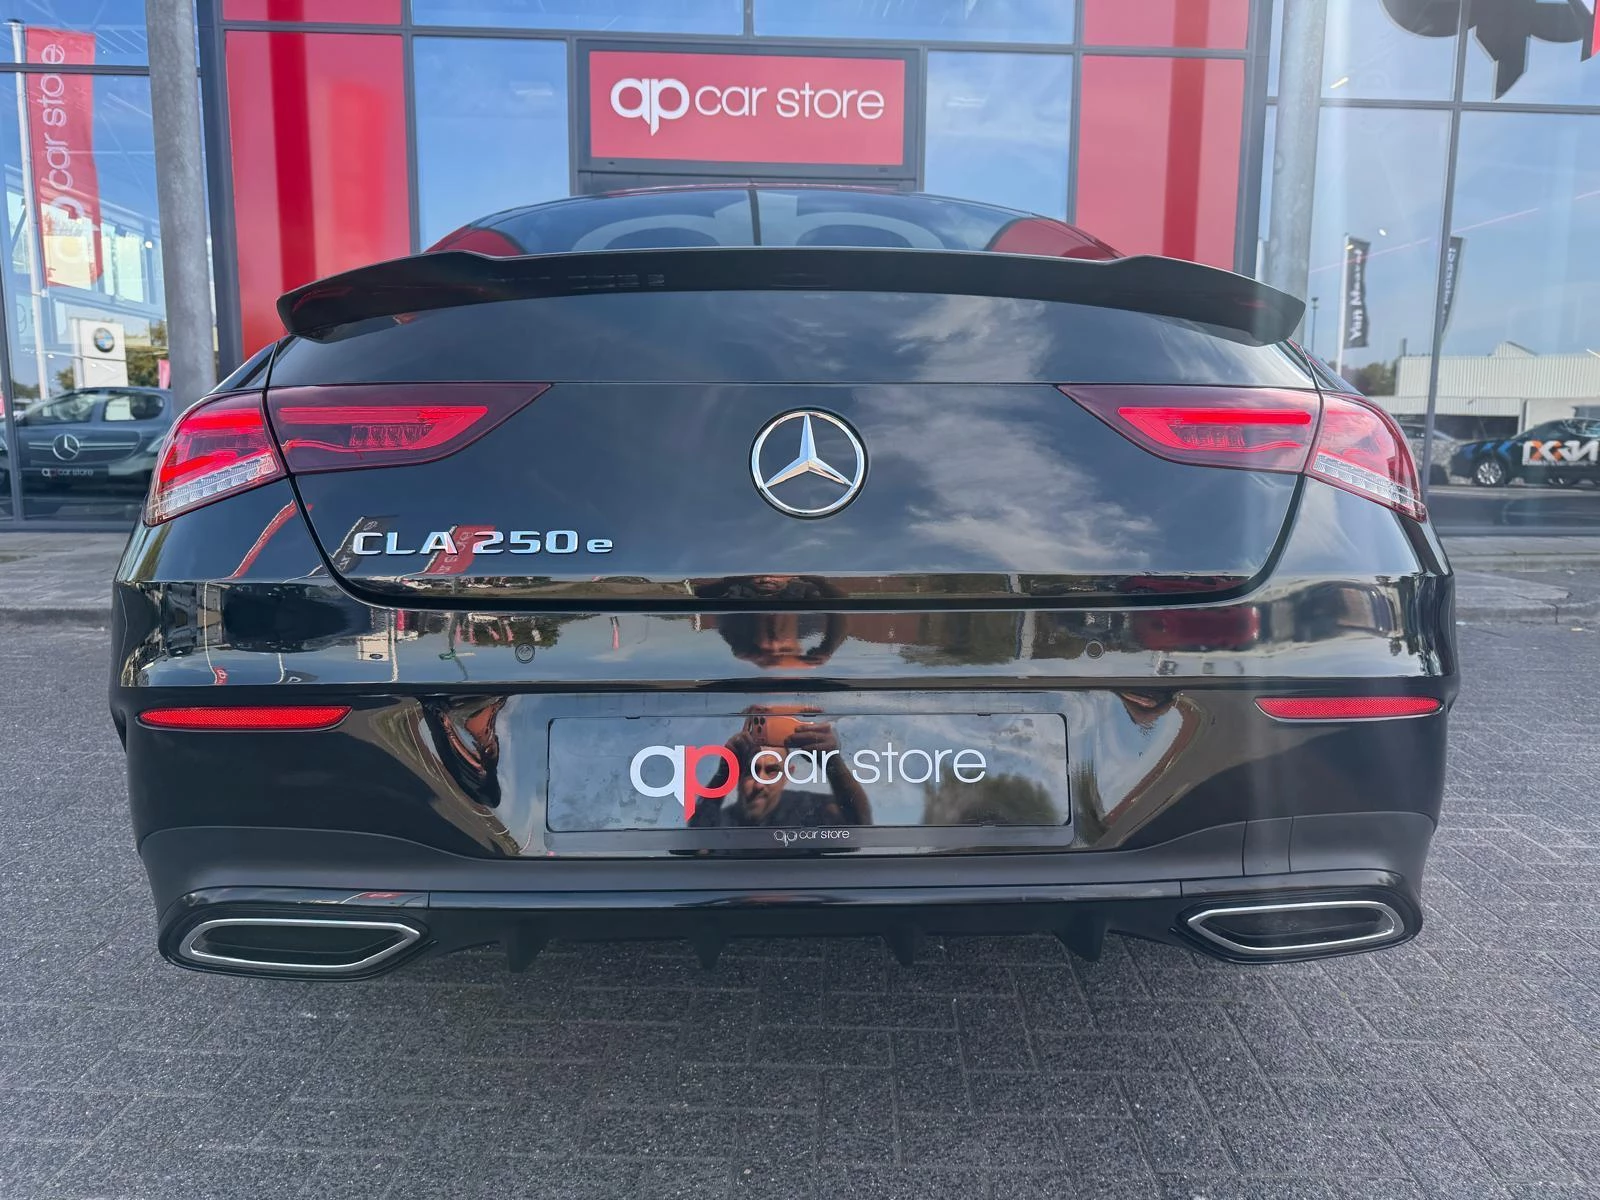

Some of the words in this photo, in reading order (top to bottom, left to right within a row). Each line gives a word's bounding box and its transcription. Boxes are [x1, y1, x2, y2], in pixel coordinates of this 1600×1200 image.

[37, 44, 67, 127] stoe
[694, 85, 767, 116] car
[776, 82, 884, 119] store
[43, 132, 73, 191] car
[352, 531, 459, 555] CLA
[750, 746, 840, 785] car
[852, 742, 987, 785] store
[799, 830, 818, 839] car
[820, 830, 850, 839] store
